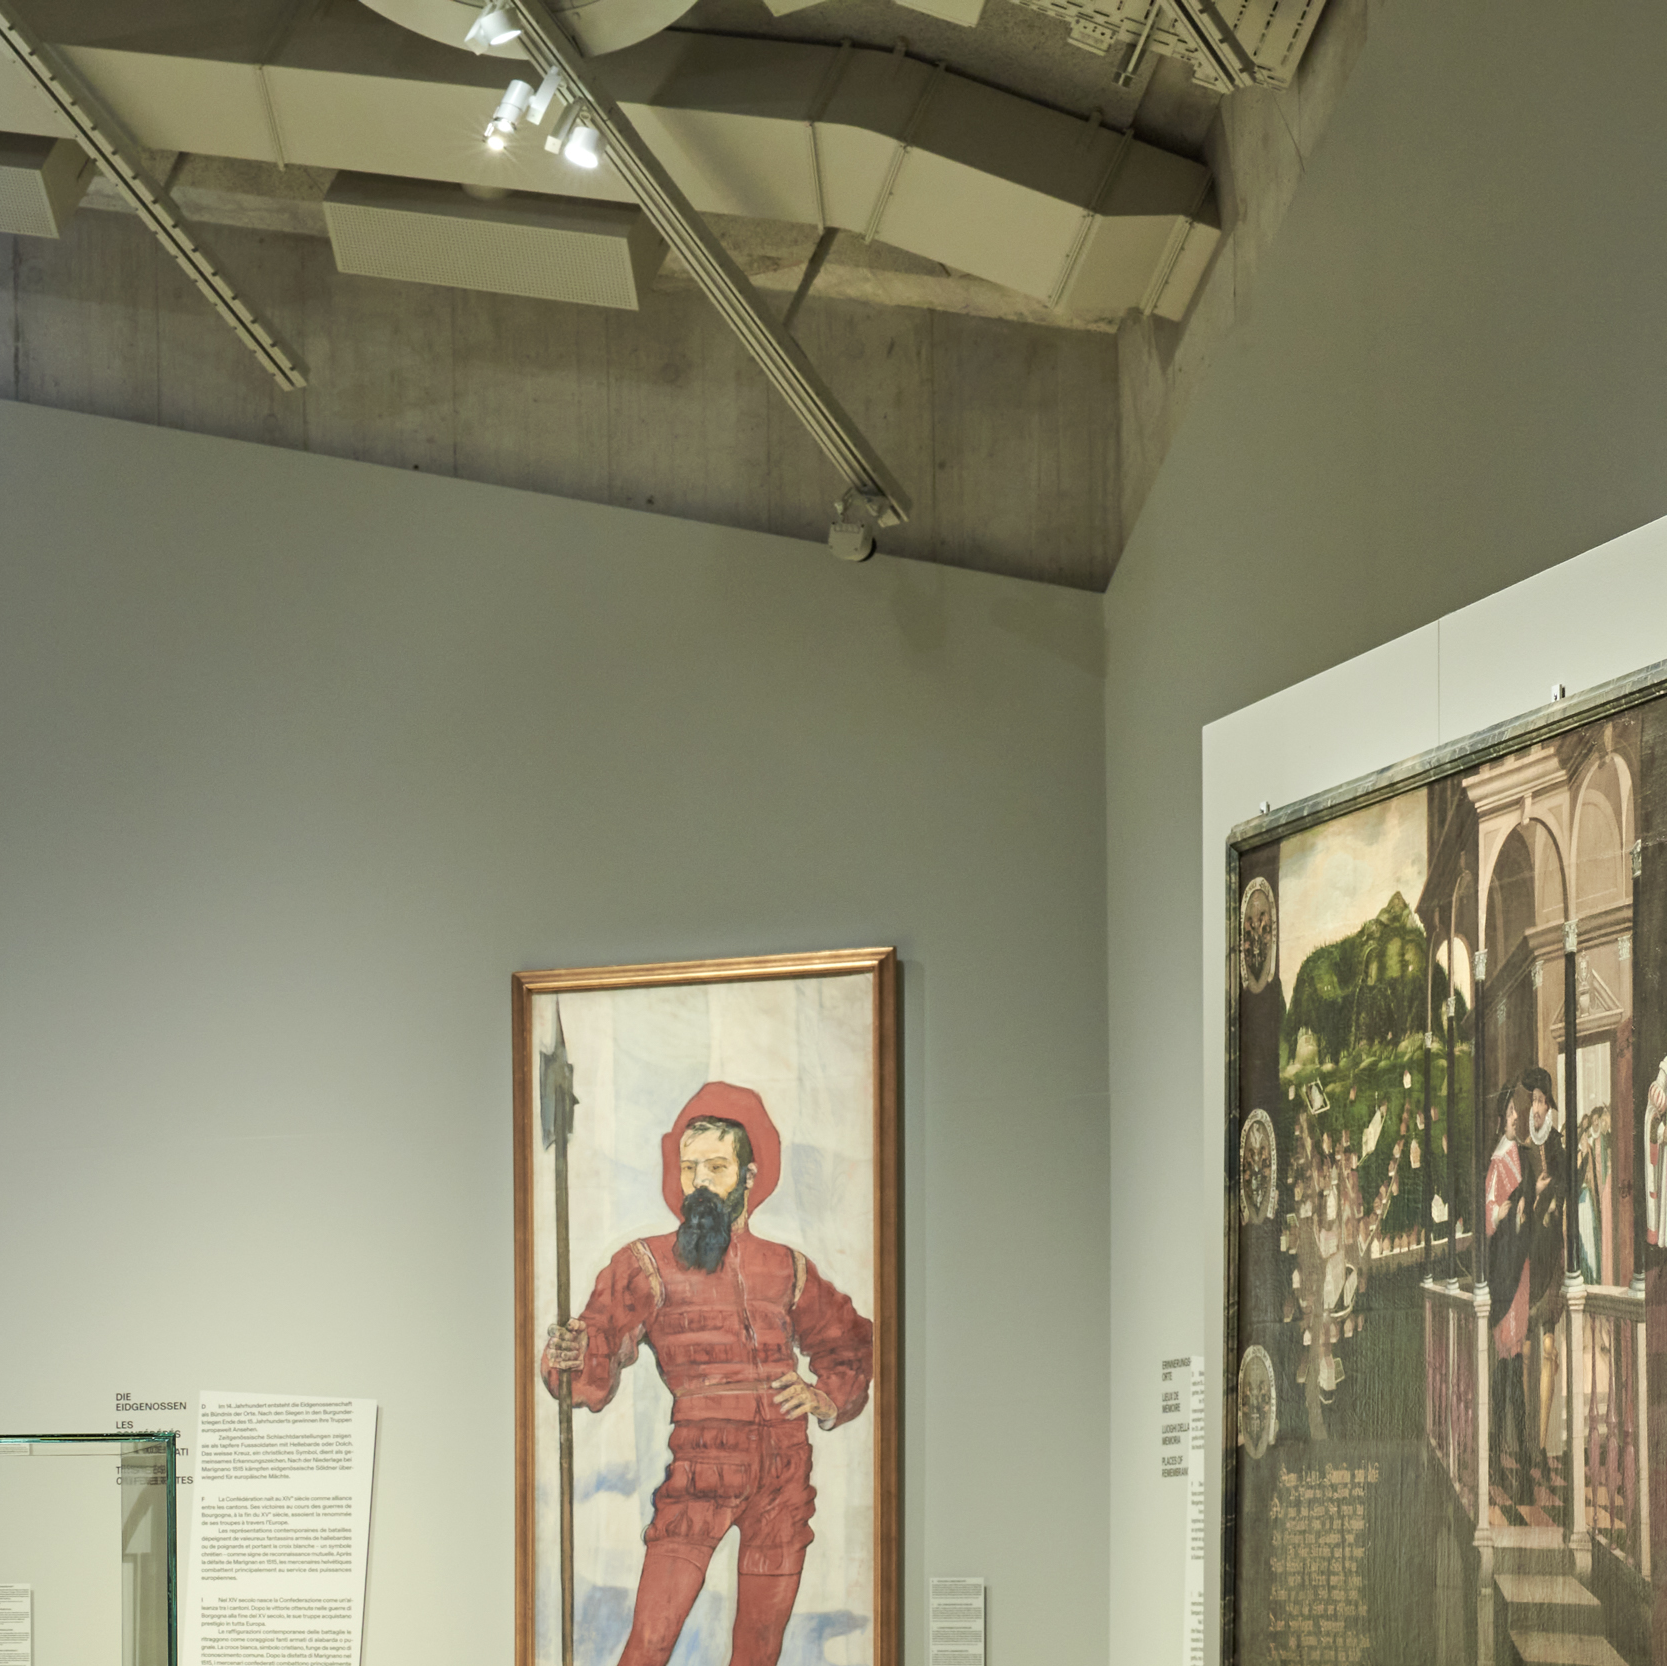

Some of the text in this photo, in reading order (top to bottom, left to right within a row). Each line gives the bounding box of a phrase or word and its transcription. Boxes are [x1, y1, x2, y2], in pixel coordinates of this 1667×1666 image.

[1162, 1371, 1172, 1381] ORTE
[116, 1393, 131, 1401] DIE
[116, 1402, 186, 1411] EIDGENOSSEN
[116, 1421, 133, 1429] LES
[1162, 1467, 1188, 1477] REMEMBRAN
